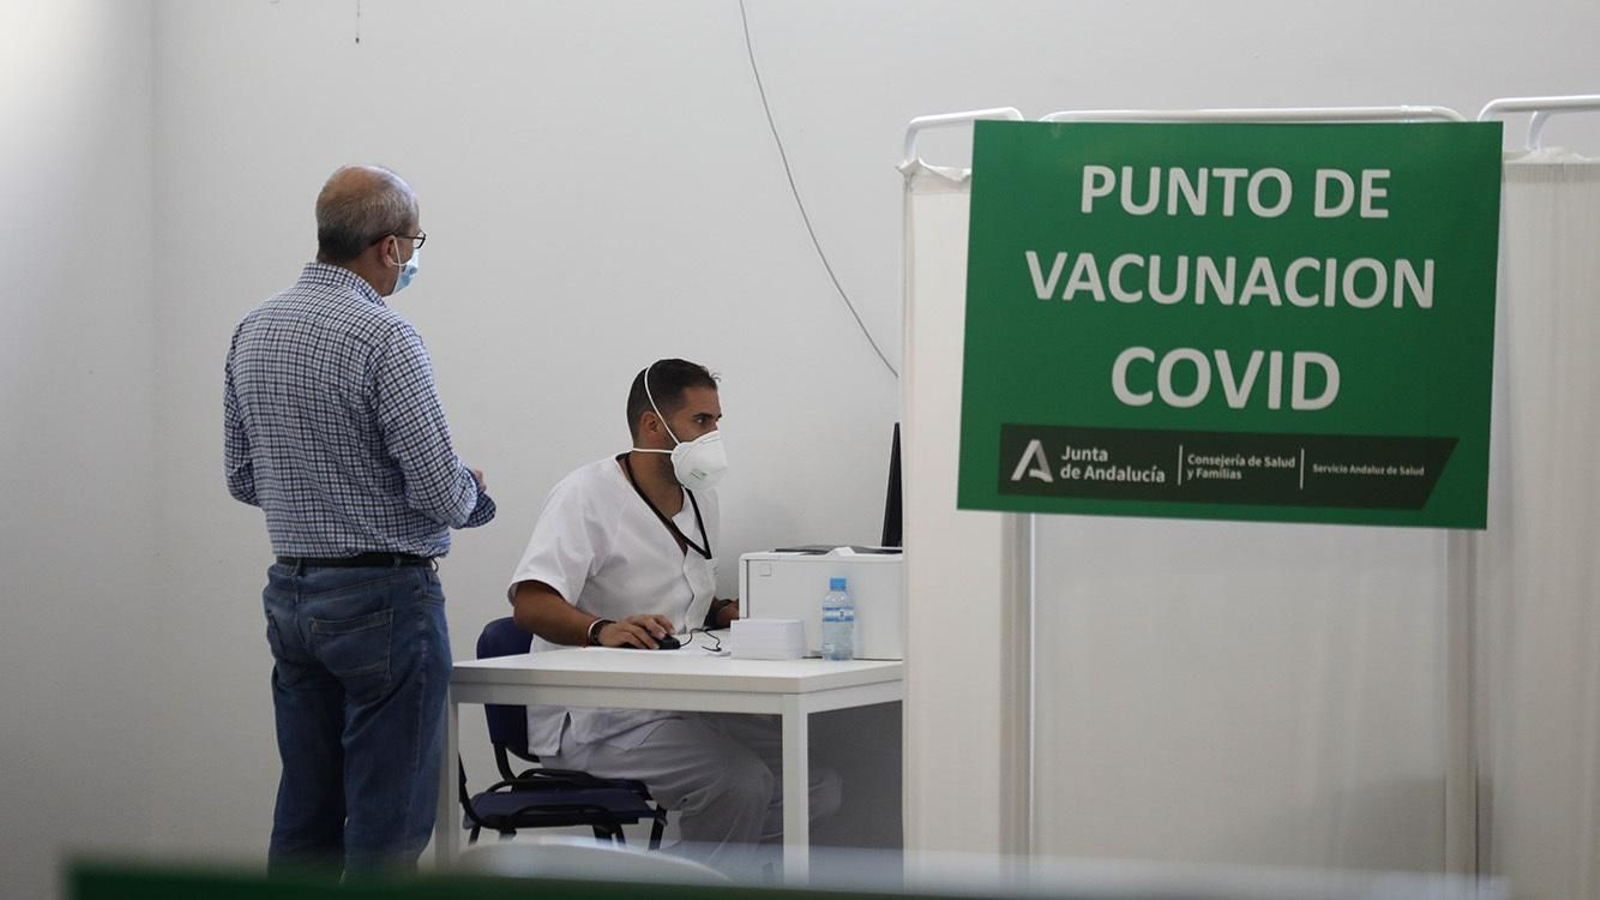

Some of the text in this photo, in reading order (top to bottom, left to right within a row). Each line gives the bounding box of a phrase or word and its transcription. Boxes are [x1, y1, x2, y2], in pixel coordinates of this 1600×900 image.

[1080, 164, 1391, 219] PUNTO DE
[1025, 250, 1435, 308] VACUNACION
[1111, 346, 1340, 410] COVID
[1061, 445, 1109, 462] Junta
[1187, 453, 1296, 468] Consejería de Salud
[1060, 463, 1166, 483] de Andalucía
[1187, 466, 1242, 481] y Familias
[1386, 465, 1398, 475] de
